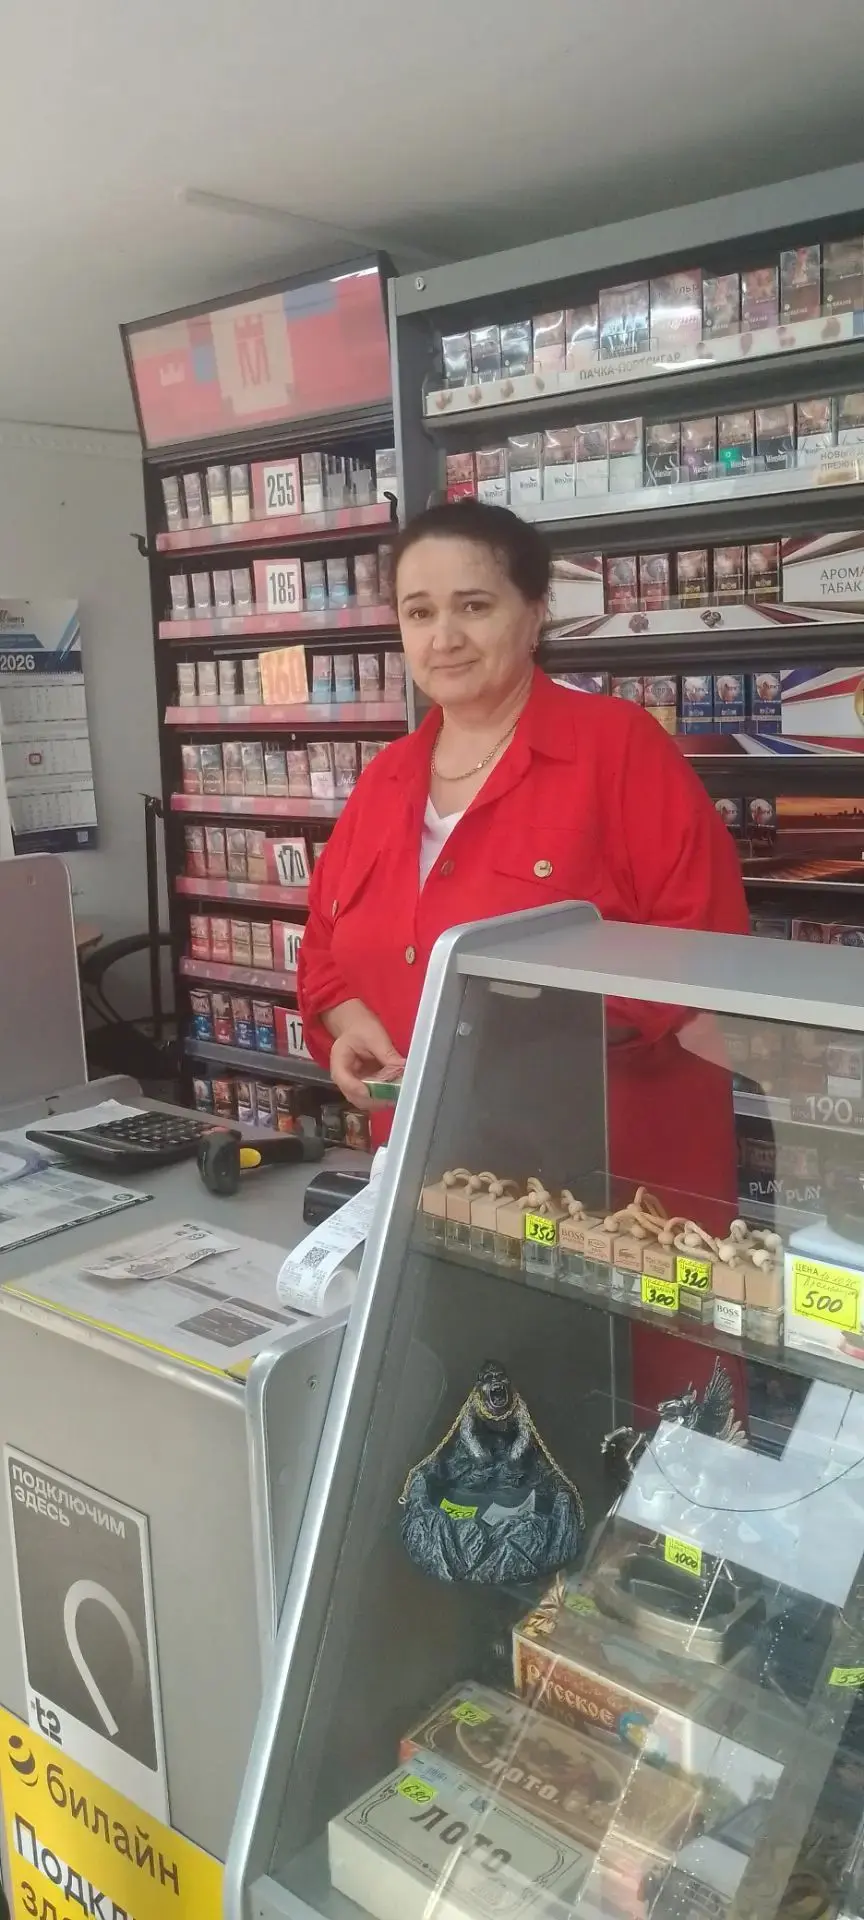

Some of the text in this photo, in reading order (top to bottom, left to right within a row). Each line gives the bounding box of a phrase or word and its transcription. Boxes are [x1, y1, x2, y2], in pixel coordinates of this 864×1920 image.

[267, 472, 295, 508] 255
[269, 571, 296, 605] 185
[820, 581, 862, 595] ТАБАК
[0, 654, 36, 671] 2026
[278, 844, 306, 883] 170
[289, 1021, 304, 1051] 17
[806, 1096, 853, 1124] 190
[749, 1180, 785, 1196] PLAY
[785, 1185, 822, 1203] PLAY
[529, 1223, 556, 1242] 350
[561, 1228, 585, 1242] BOSS
[681, 1268, 709, 1289] 320
[795, 1262, 819, 1277] ЦЕНА
[648, 1288, 675, 1306] 300
[802, 1290, 843, 1313] 500
[717, 1304, 739, 1317] BOSS
[12, 1464, 125, 1539] ПОДКЛЮЧИМ
[14, 1485, 70, 1528] ЗДЕСЬ
[675, 1552, 698, 1568] 1000
[34, 1697, 63, 1746] t2
[402, 1784, 431, 1803] 680
[46, 1763, 180, 1896] билайн
[409, 1803, 513, 1873] ЛОТО
[21, 1880, 71, 1920] зд
